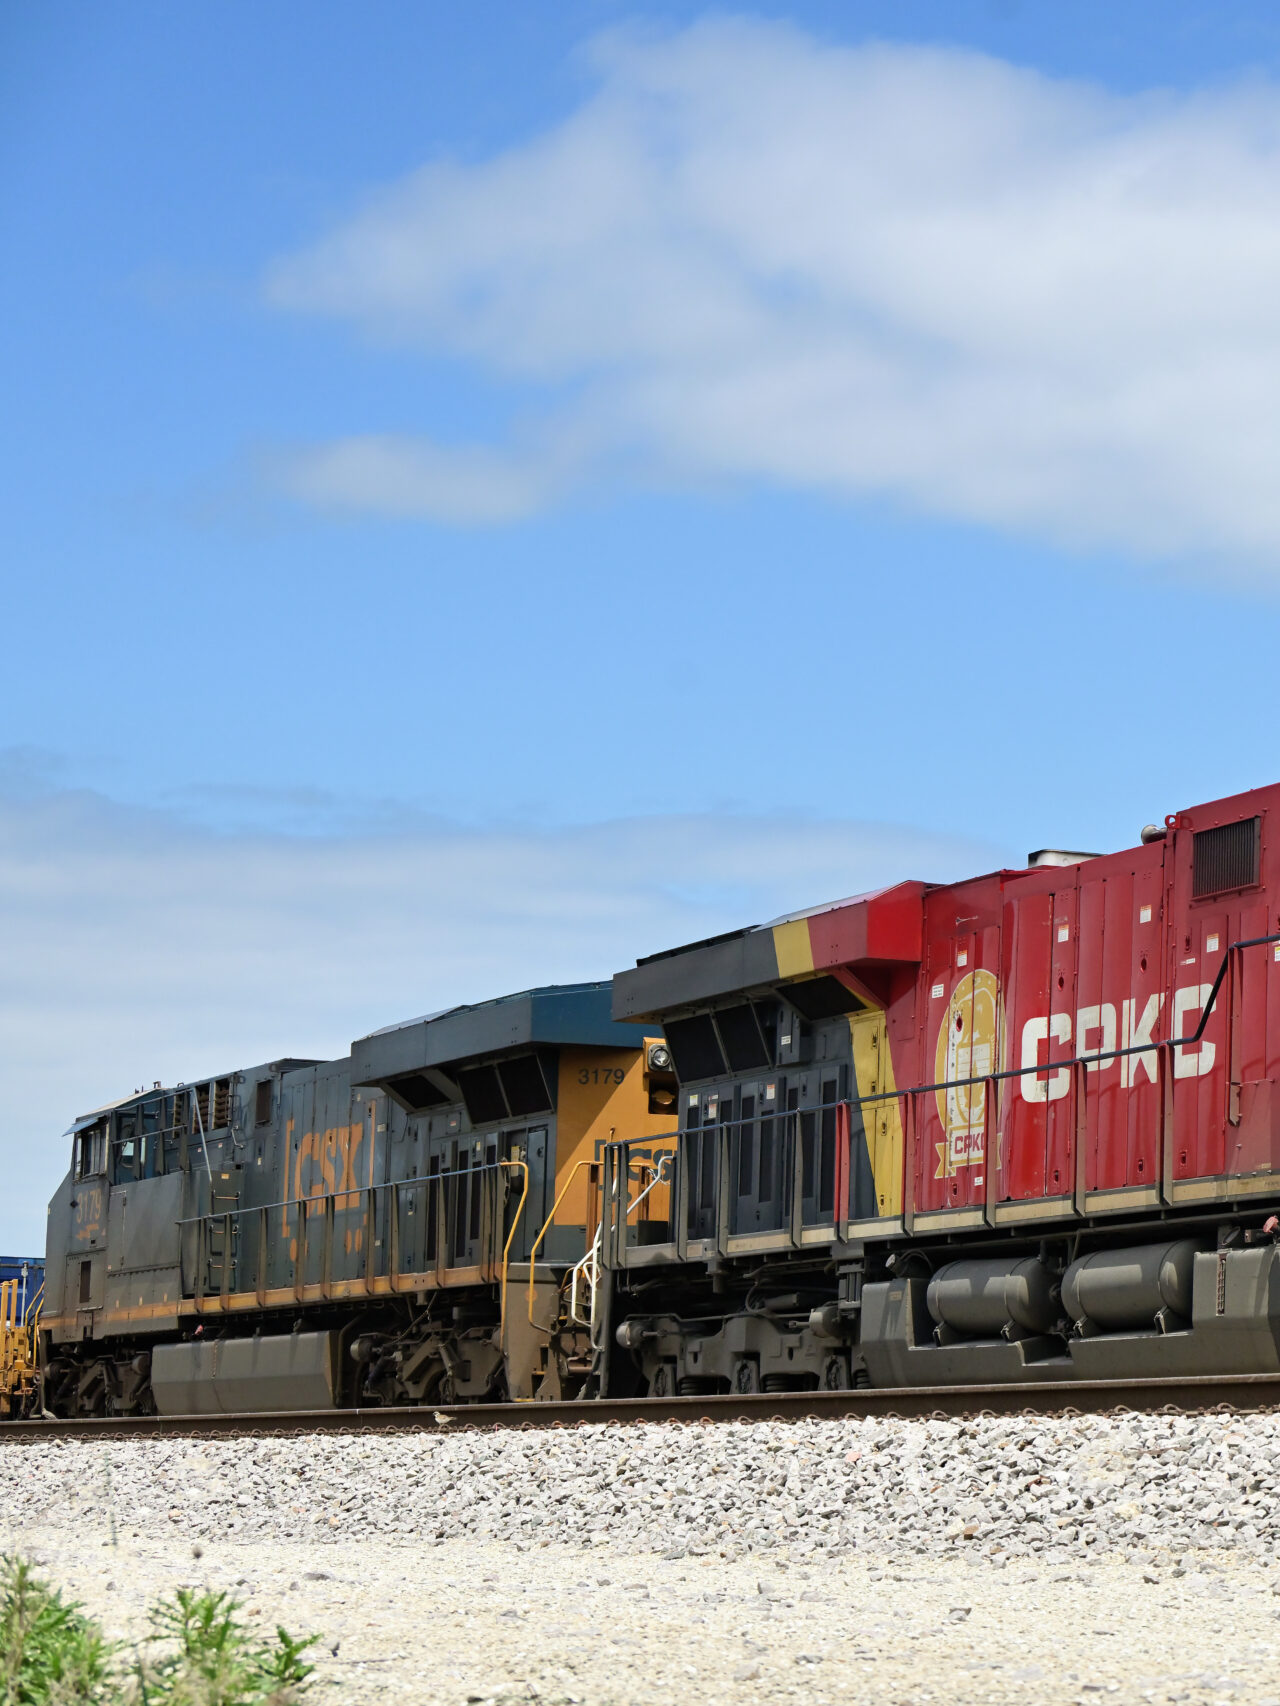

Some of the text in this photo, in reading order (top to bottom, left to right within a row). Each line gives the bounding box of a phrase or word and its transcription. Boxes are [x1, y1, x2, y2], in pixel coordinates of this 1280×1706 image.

[1020, 983, 1217, 1103] CPKC
[578, 1068, 625, 1085] 3179
[294, 1122, 363, 1219] CSX
[628, 1148, 677, 1182] CS
[76, 1188, 102, 1224] 3179
